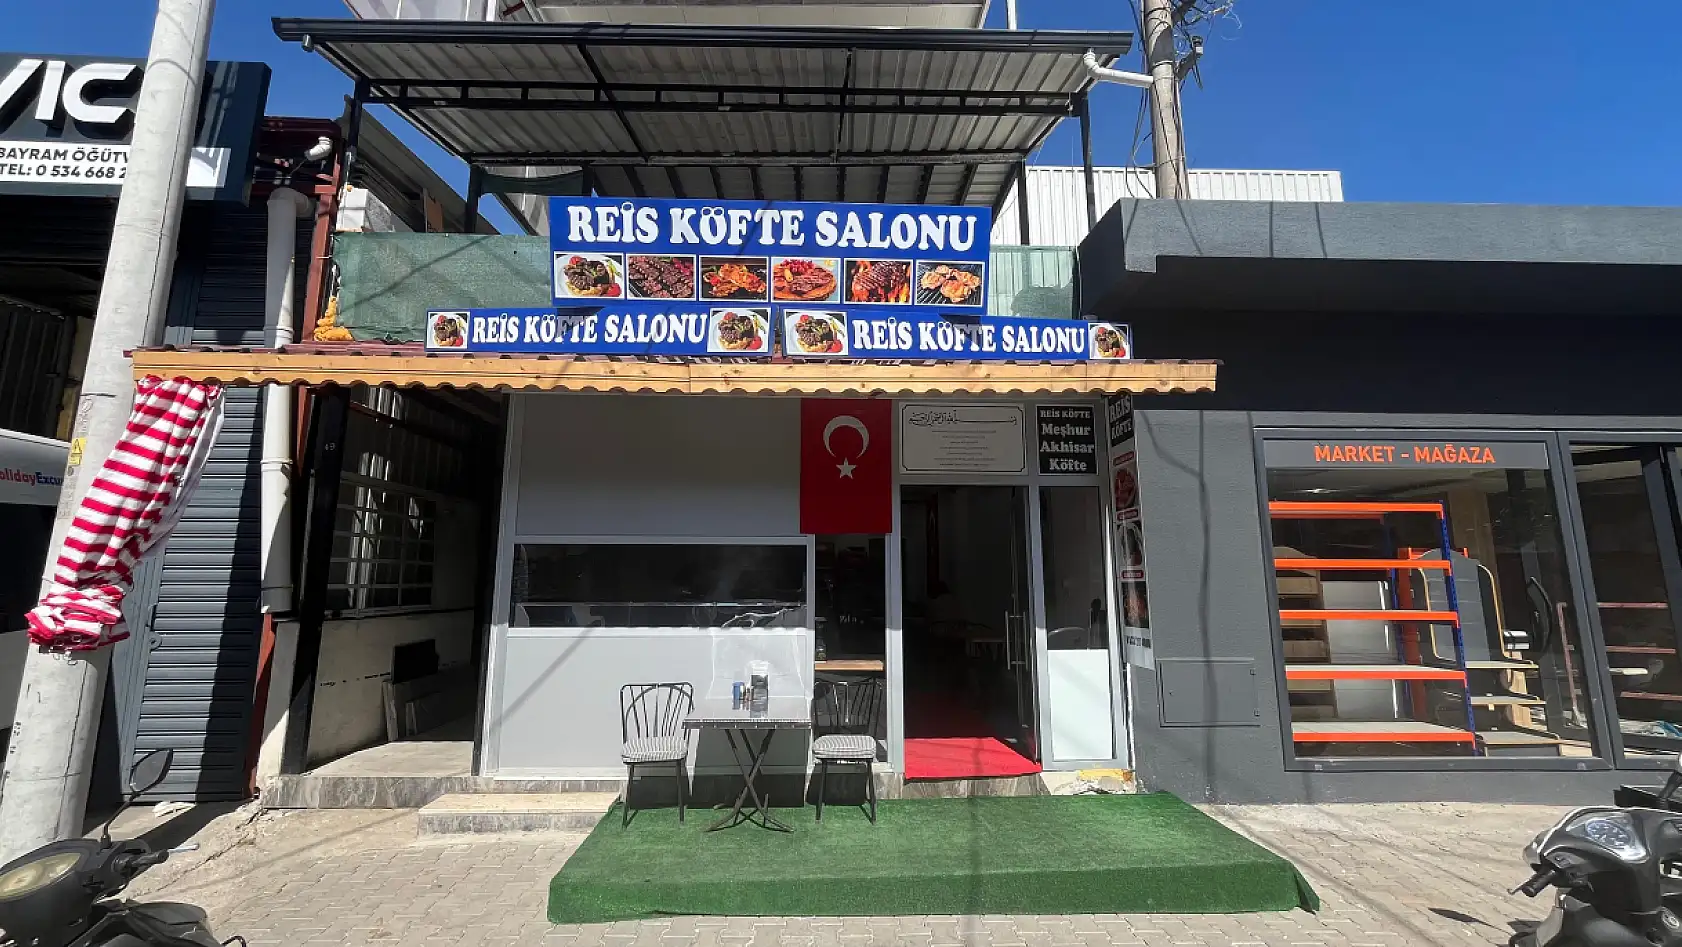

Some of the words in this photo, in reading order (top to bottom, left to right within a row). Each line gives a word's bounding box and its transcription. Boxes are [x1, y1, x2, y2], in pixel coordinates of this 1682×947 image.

[0, 164, 32, 175] TEL:
[36, 164, 47, 176] 0
[50, 166, 81, 177] 534
[85, 167, 116, 178] 668
[568, 201, 660, 244] REİS
[669, 206, 805, 247] KÖFTE
[815, 211, 977, 251] SALONU
[472, 312, 520, 344] REİS
[523, 314, 599, 344] KÖFTE
[604, 314, 708, 344] SALONU
[852, 317, 913, 350] REİS
[918, 321, 997, 352] KÖFTE
[1002, 325, 1085, 354] SALONU
[1041, 423, 1091, 438] Meşhur
[1040, 441, 1094, 453] Akhisar
[1314, 445, 1395, 462] MARKET
[1413, 443, 1496, 464] MAĞAZA
[1049, 458, 1087, 471] Köfte
